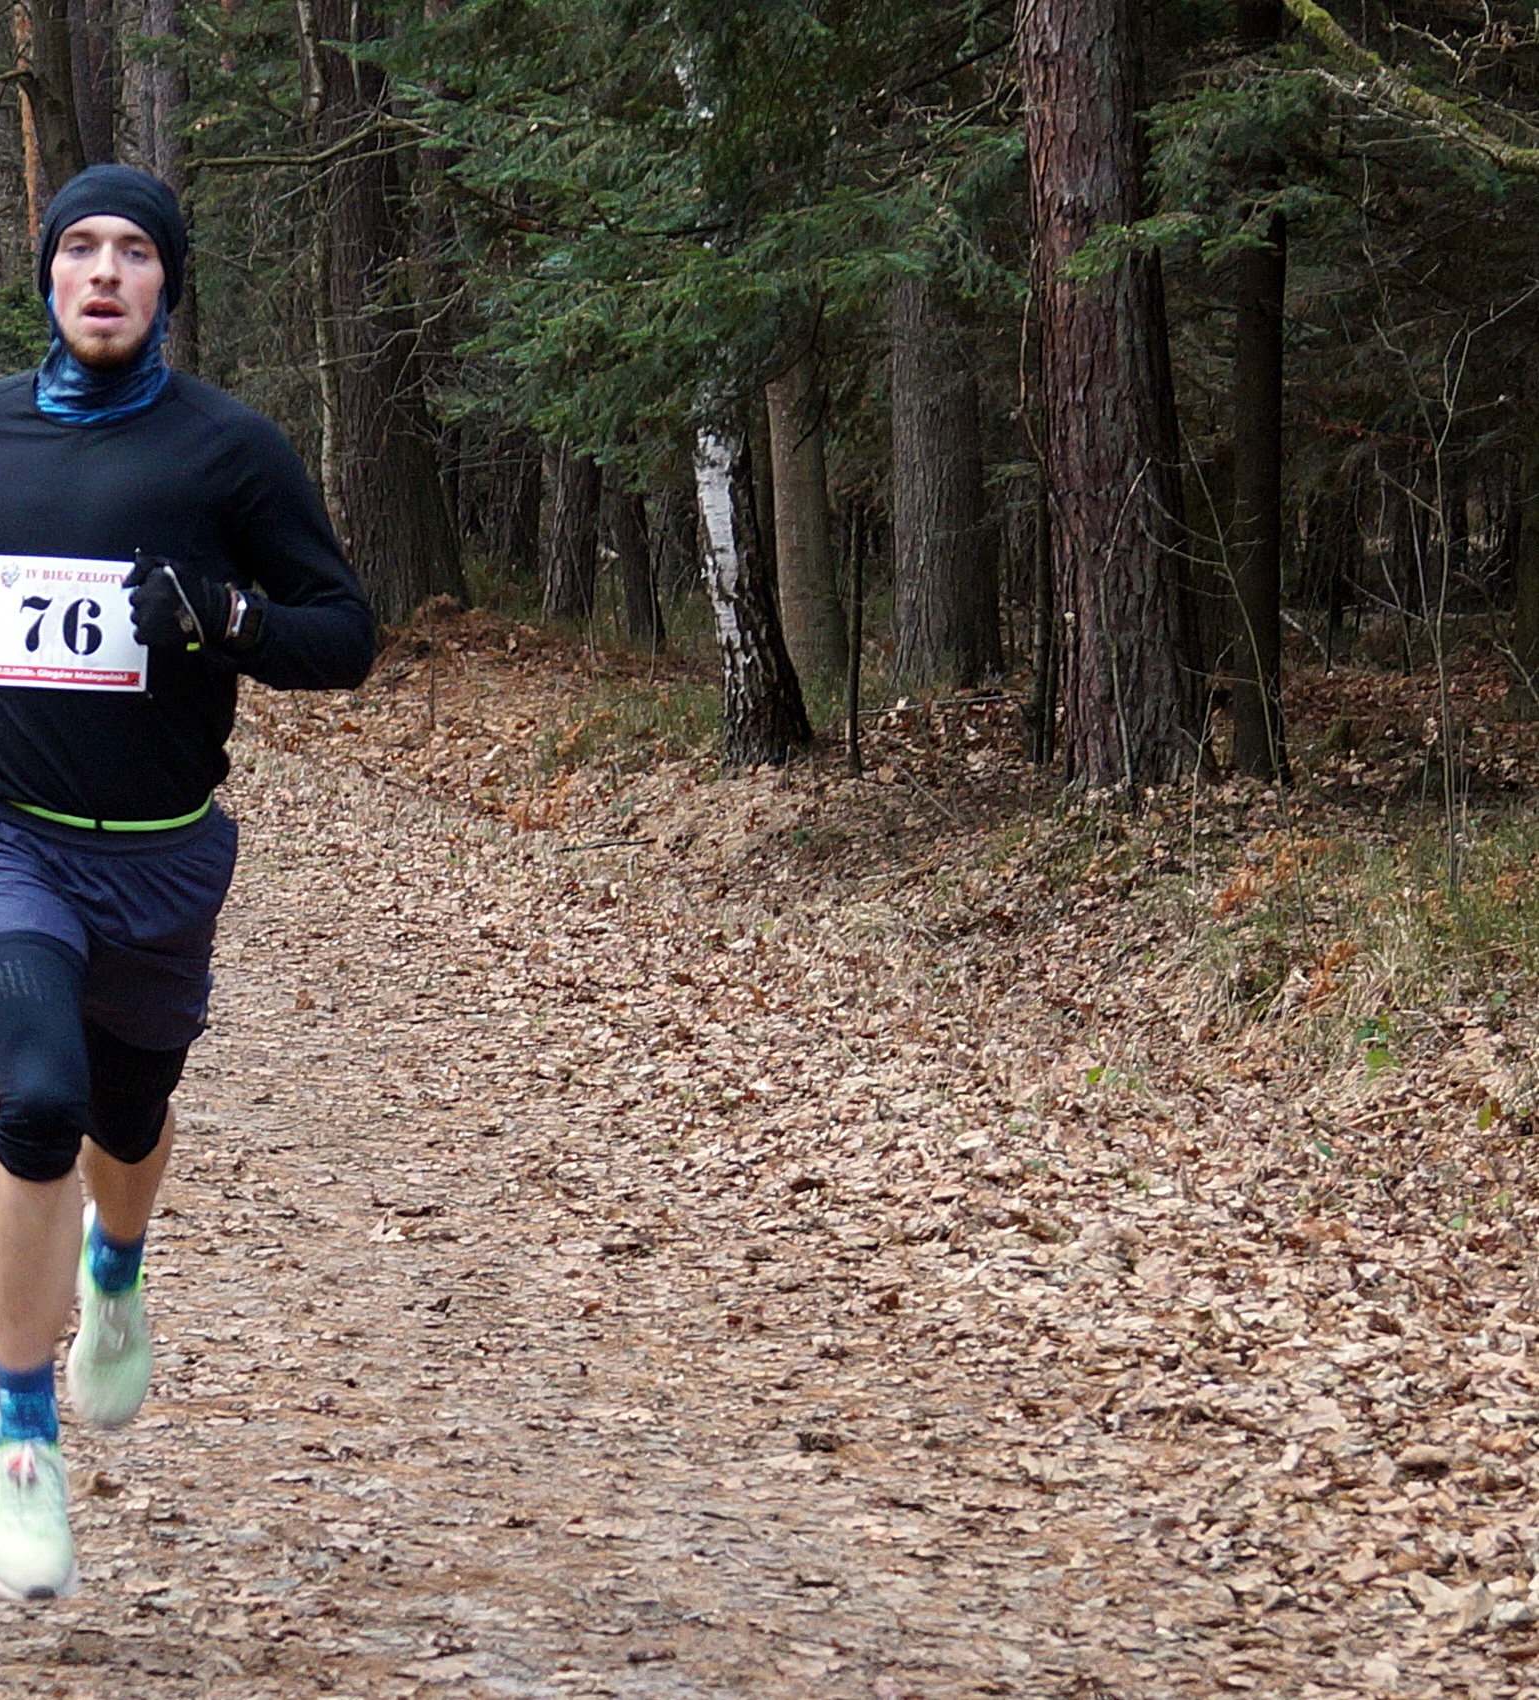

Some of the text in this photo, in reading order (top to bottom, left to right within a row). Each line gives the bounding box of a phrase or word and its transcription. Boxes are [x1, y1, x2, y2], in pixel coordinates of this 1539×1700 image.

[25, 569, 38, 579] IV
[42, 569, 73, 581] BIEG
[19, 595, 103, 656] 76
